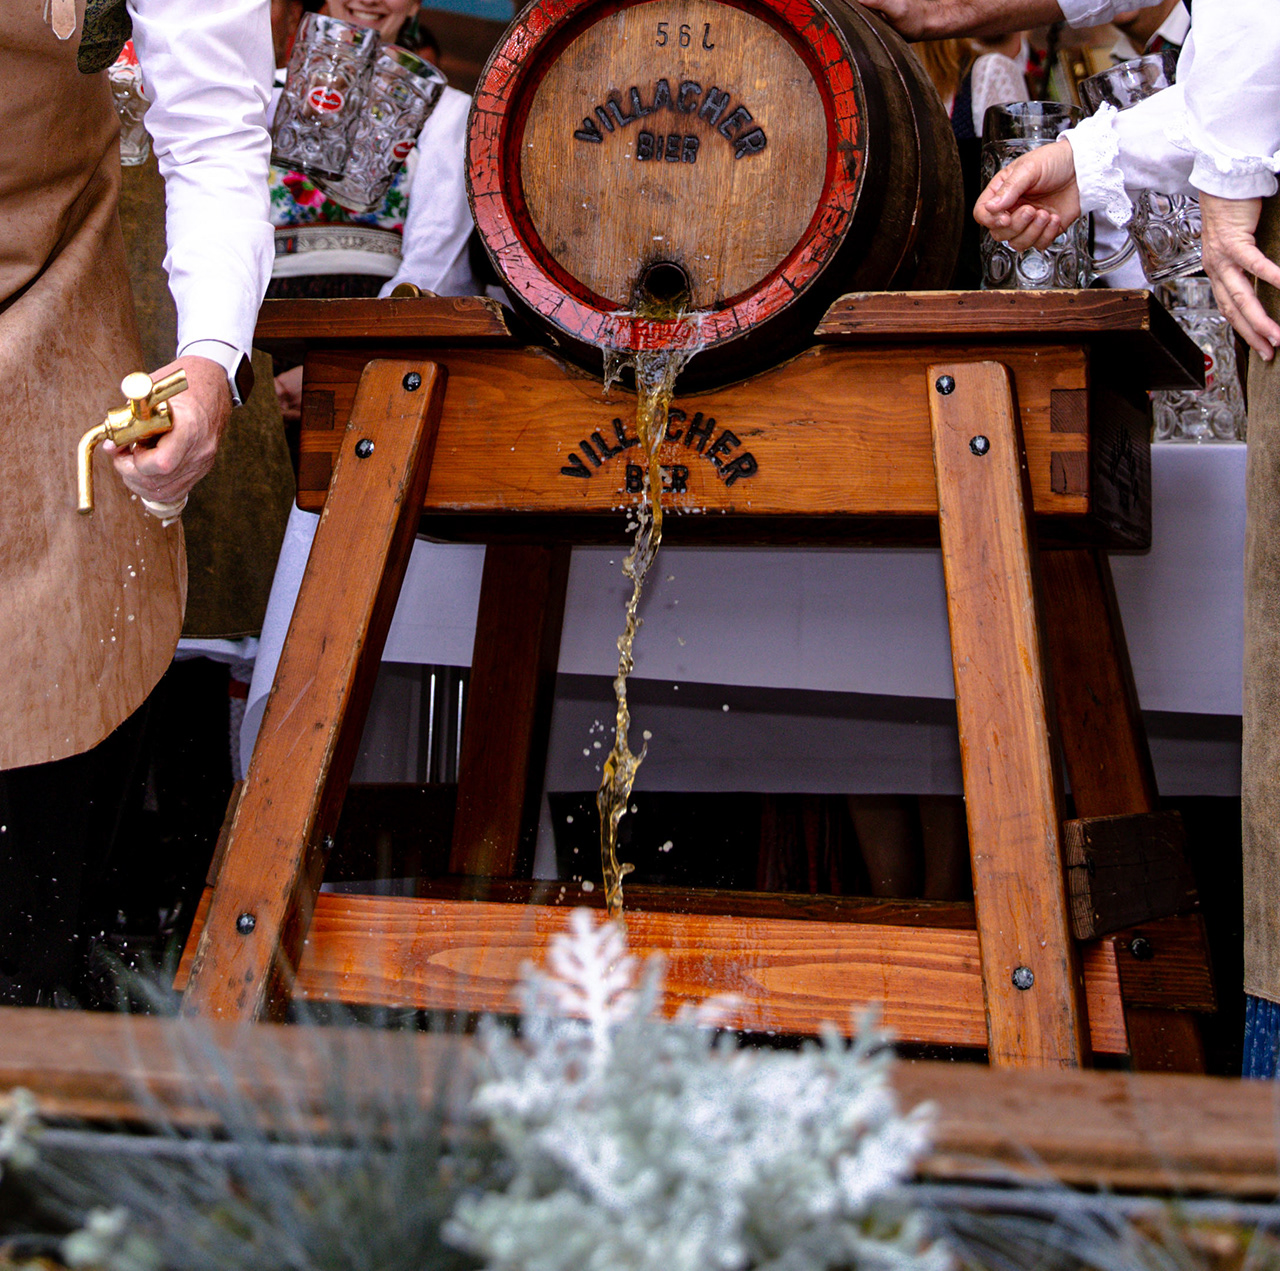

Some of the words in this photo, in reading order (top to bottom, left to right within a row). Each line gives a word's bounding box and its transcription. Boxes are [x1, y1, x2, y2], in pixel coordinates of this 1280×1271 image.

[574, 79, 767, 160] VILLACHER
[636, 131, 700, 163] BIER
[560, 408, 758, 488] VILLCHER
